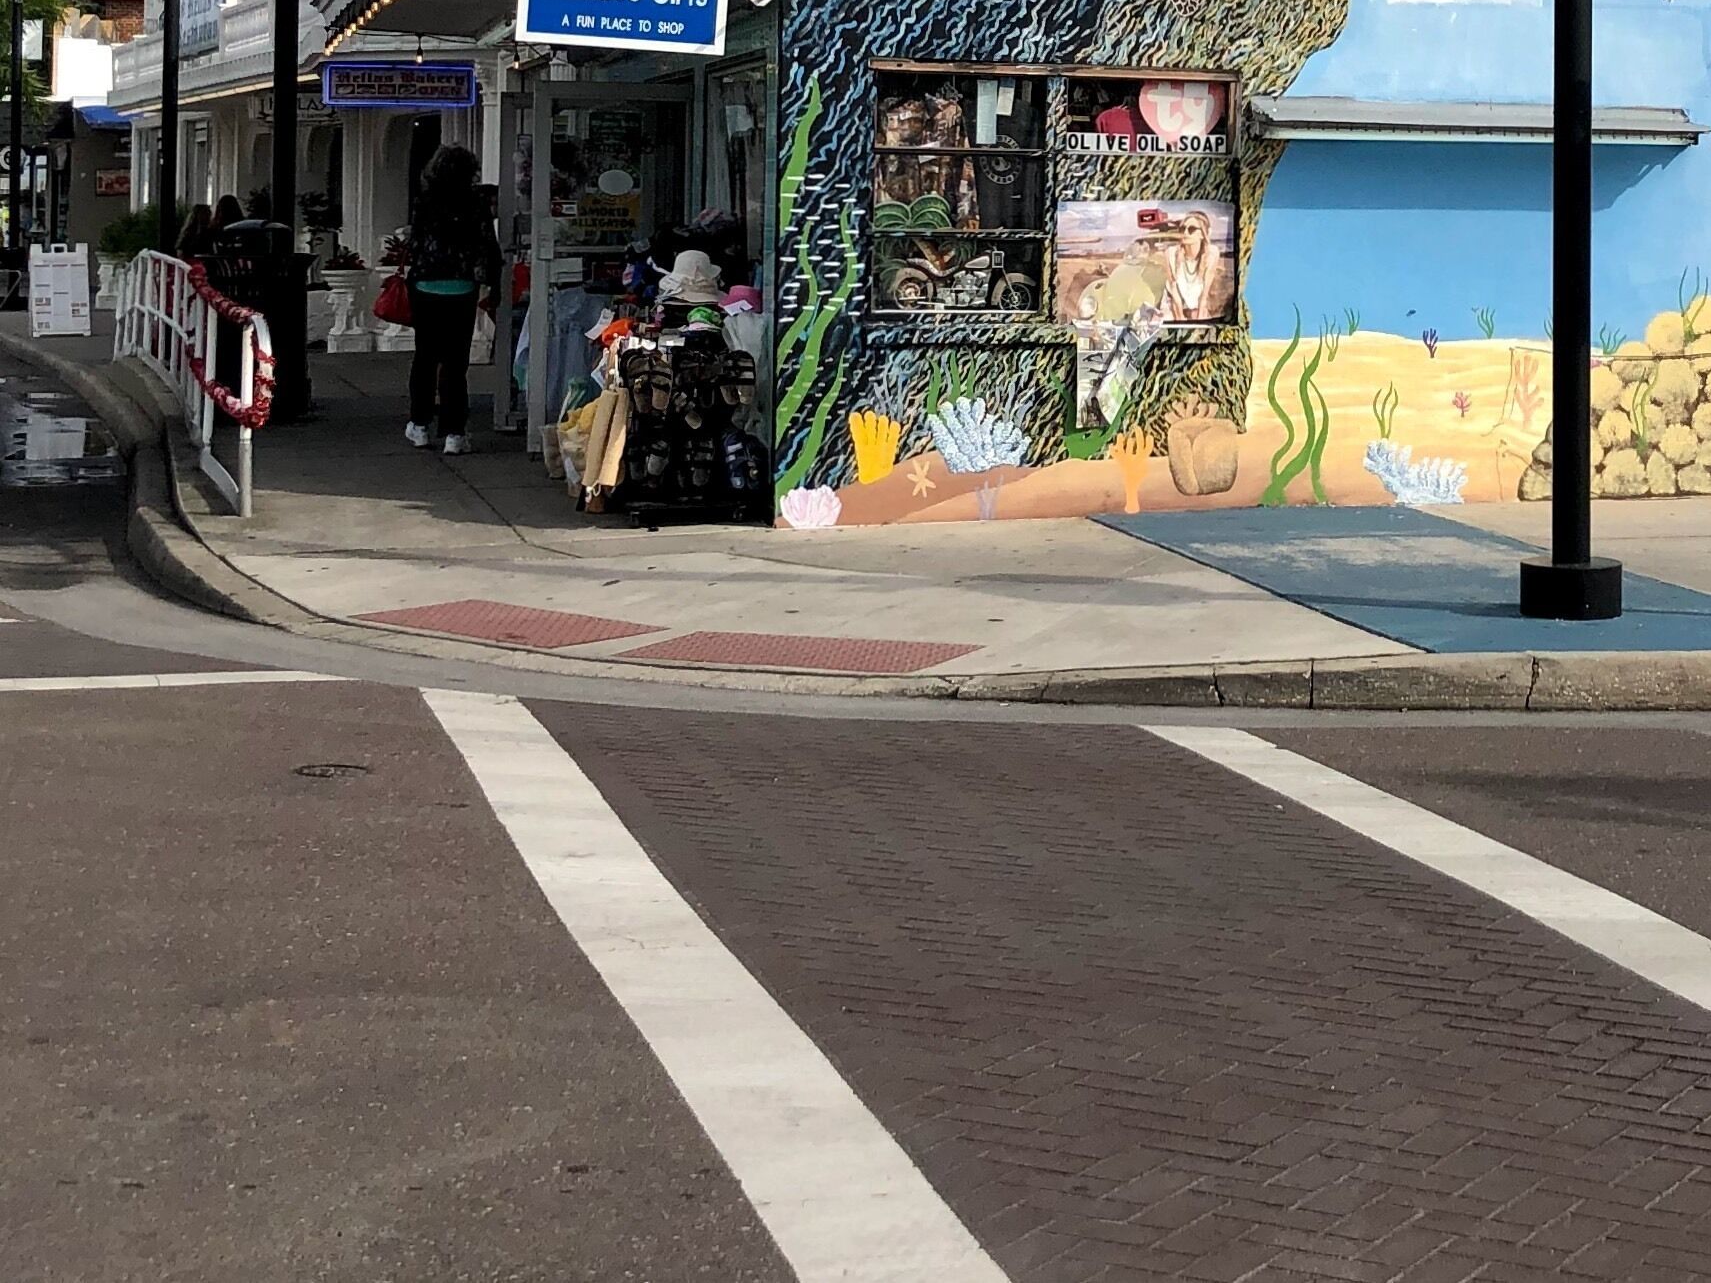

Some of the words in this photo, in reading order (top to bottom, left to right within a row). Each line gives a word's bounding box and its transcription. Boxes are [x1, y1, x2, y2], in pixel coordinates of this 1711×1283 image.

[562, 14, 570, 27] A
[576, 15, 595, 28] FUN
[601, 17, 632, 31] PLACE
[638, 20, 651, 32] TO
[658, 21, 684, 35] SHOP
[335, 71, 393, 84] Hellas
[400, 71, 465, 86] Bakery
[418, 86, 462, 96] OPEN
[1068, 134, 1129, 151] OLIVE
[1138, 135, 1167, 152] OIL
[1179, 135, 1225, 152] SOAP
